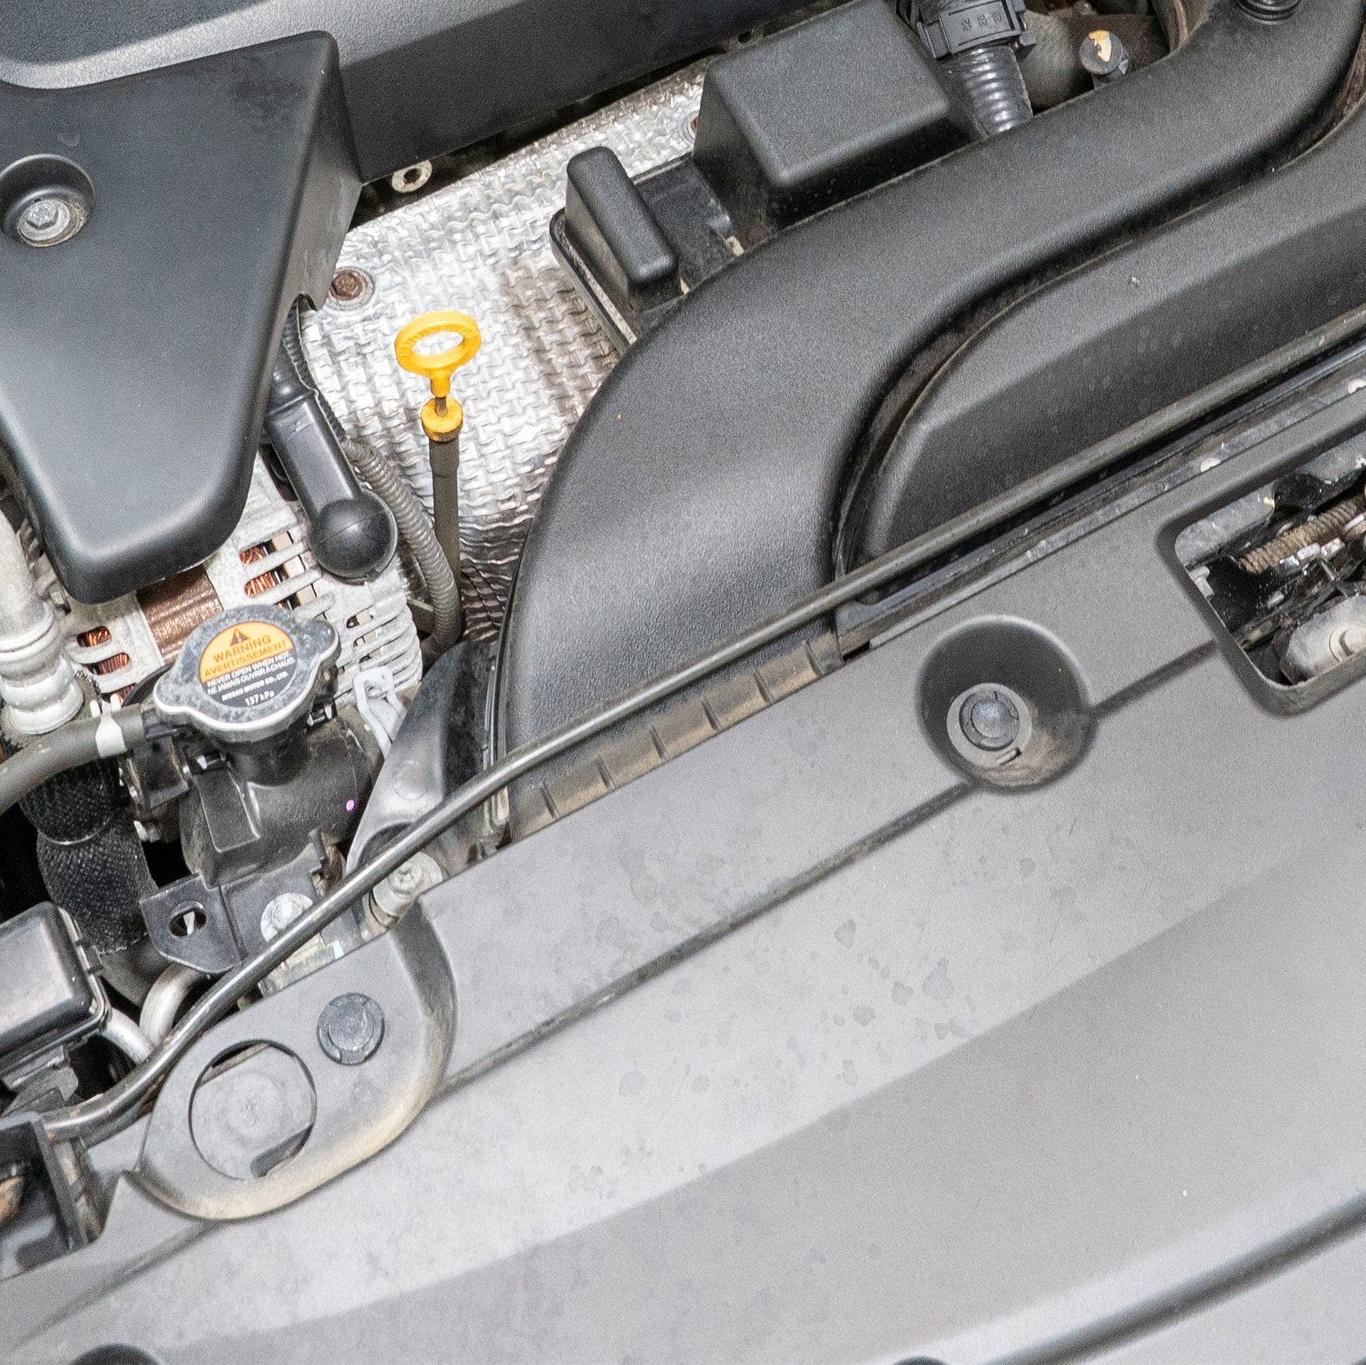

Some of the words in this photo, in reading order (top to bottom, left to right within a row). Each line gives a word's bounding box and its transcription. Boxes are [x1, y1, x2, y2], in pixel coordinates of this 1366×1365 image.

[205, 640, 286, 677] AVERTISSEMENT
[213, 635, 271, 663] WARNING
[231, 666, 252, 679] OPEN
[245, 694, 259, 706] 137
